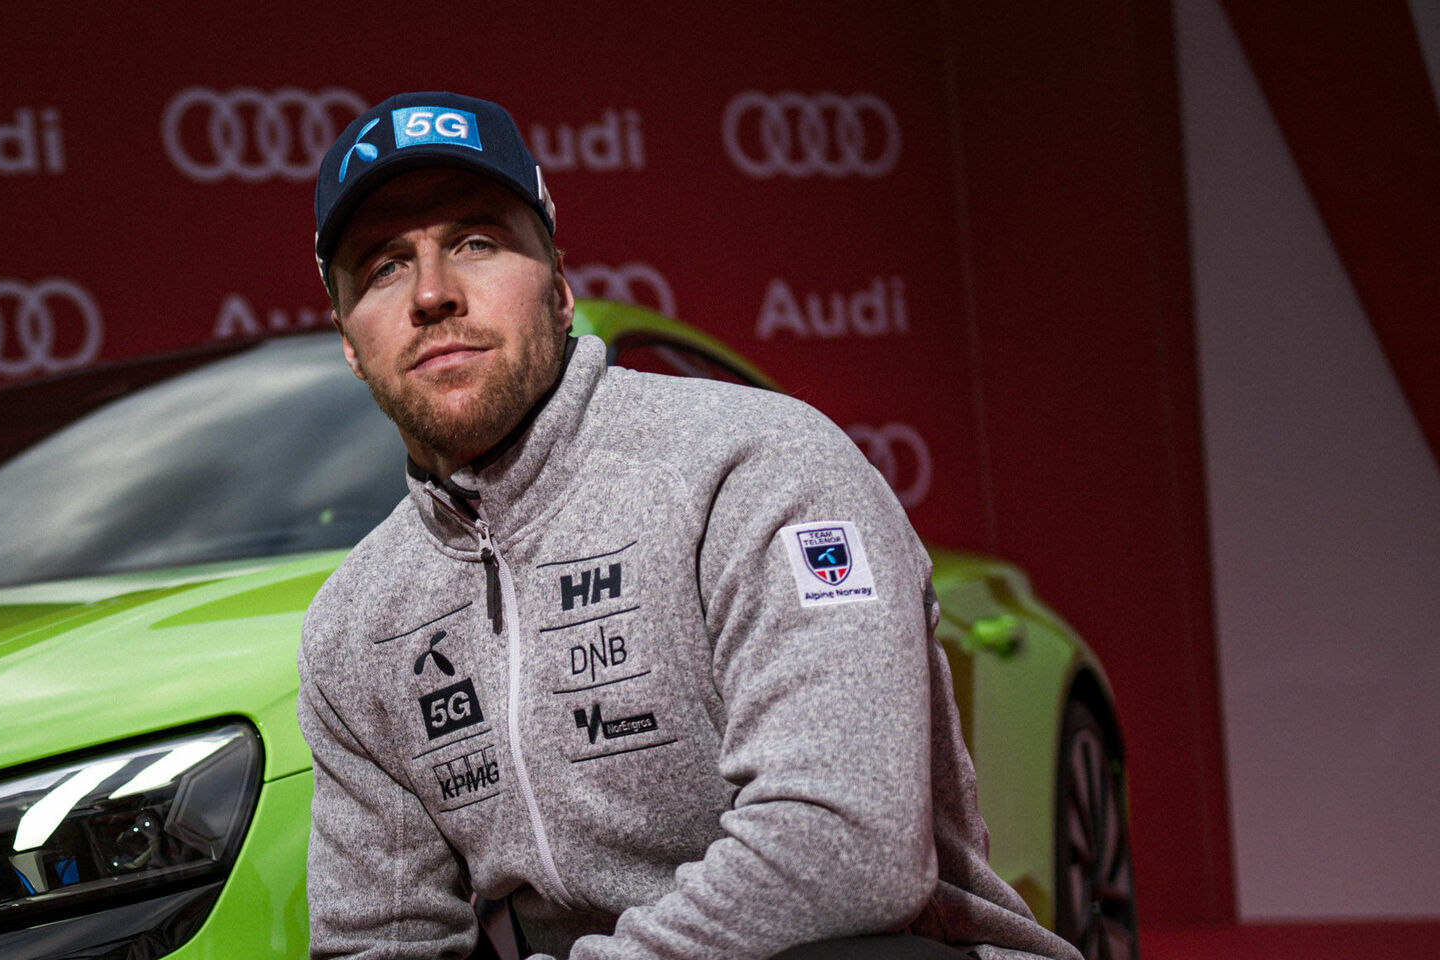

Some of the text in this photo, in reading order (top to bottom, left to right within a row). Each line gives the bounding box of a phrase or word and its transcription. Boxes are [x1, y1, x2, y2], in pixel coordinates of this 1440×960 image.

[404, 111, 470, 139] 5G
[529, 107, 645, 172] udi
[755, 278, 907, 339] Audi
[561, 563, 621, 611] HH
[805, 587, 872, 600] Alpine Norway
[571, 626, 627, 682] DNB
[430, 691, 472, 728] 5G
[439, 761, 499, 801] KPMG
